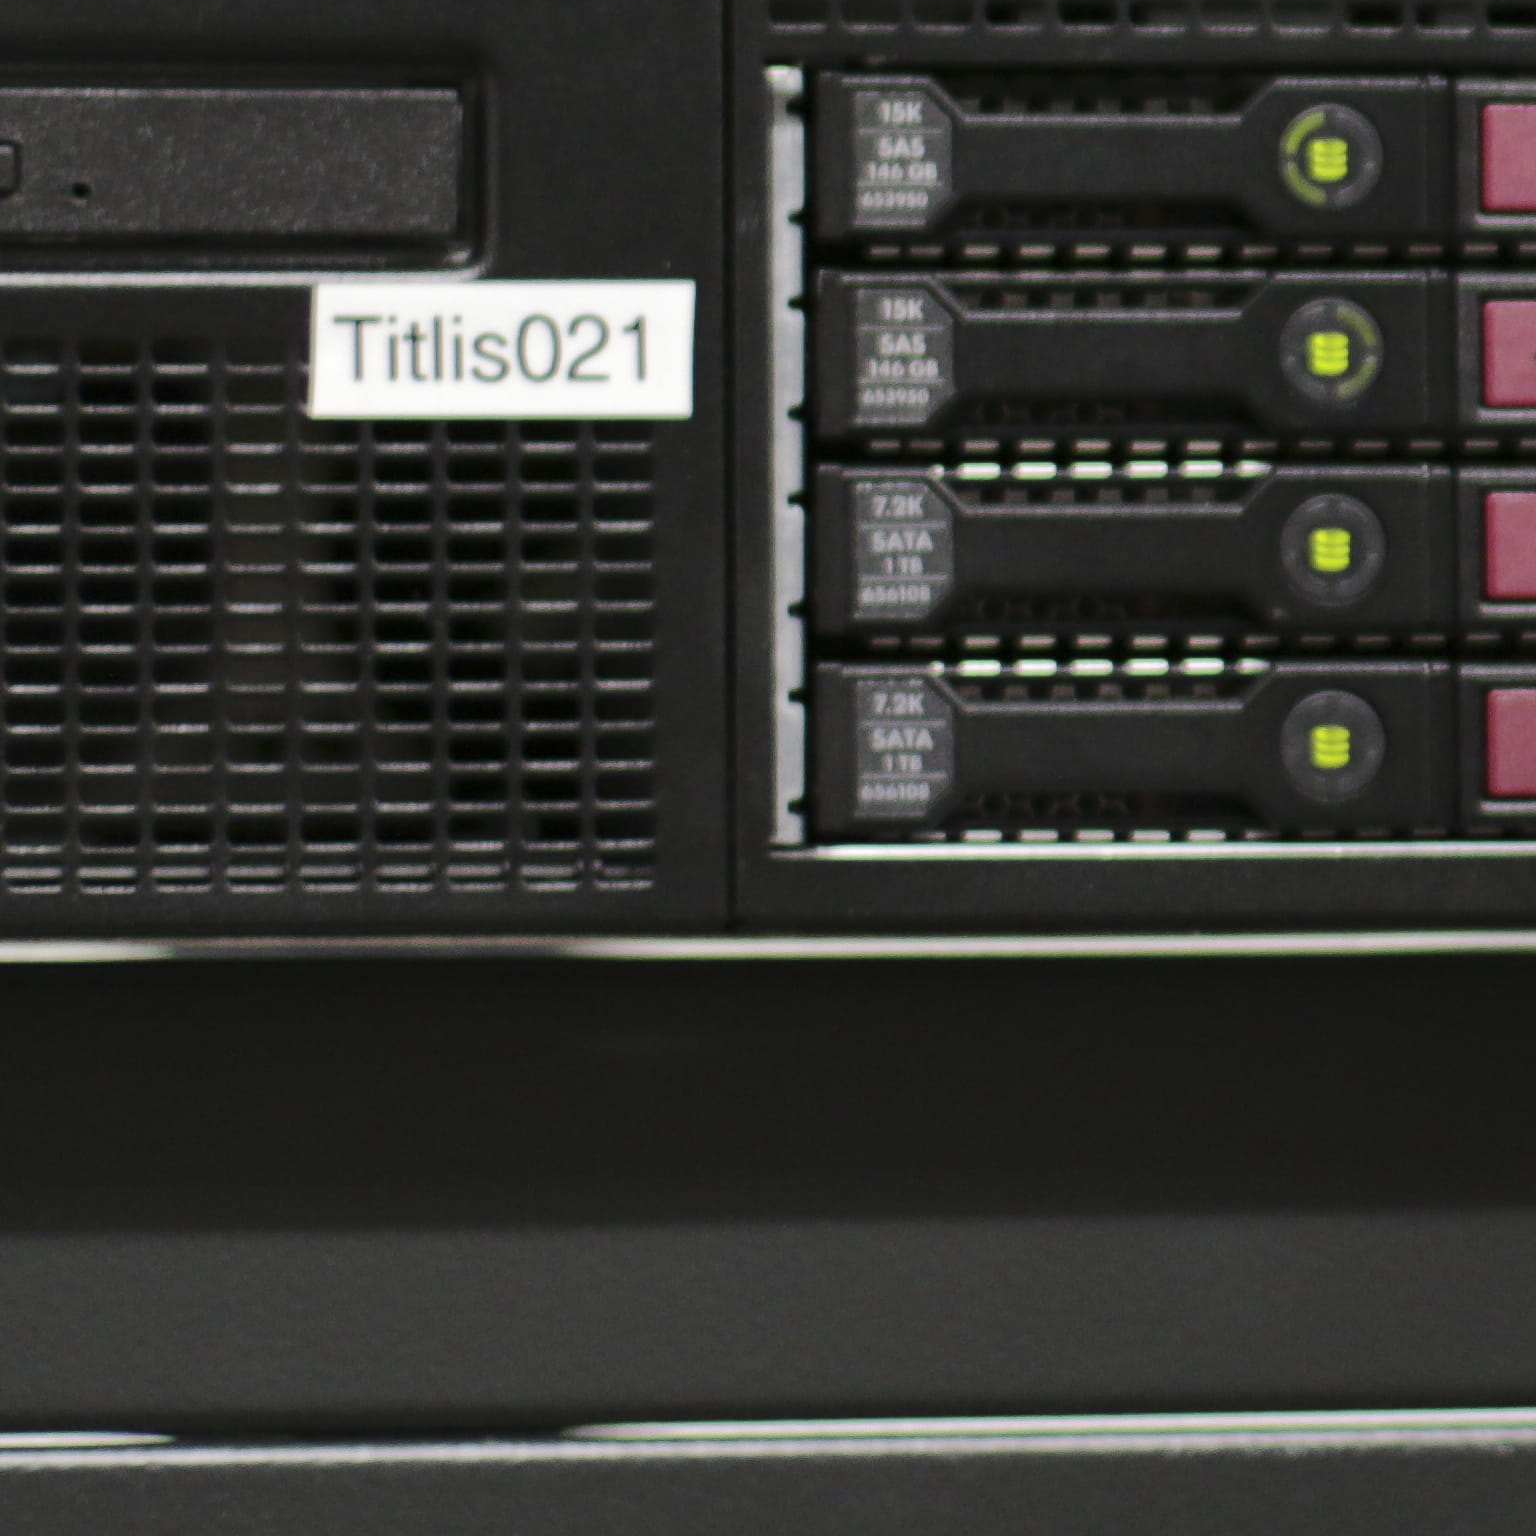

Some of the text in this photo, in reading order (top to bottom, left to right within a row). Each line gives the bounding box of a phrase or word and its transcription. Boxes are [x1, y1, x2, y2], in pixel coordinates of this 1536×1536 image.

[880, 103, 922, 123] 15K
[880, 138, 924, 158] SAS
[866, 162, 937, 181] 146 GB
[881, 300, 922, 320] 15K
[333, 315, 649, 383] Titlis021
[880, 334, 925, 354] SAS
[868, 358, 938, 378] 146 GB
[873, 496, 922, 517] 7.2K
[871, 531, 932, 552] SATA
[884, 559, 922, 575] 1 TB
[873, 694, 922, 714] 7.2K
[870, 729, 932, 750] SATA
[884, 754, 922, 771] 1 TB
